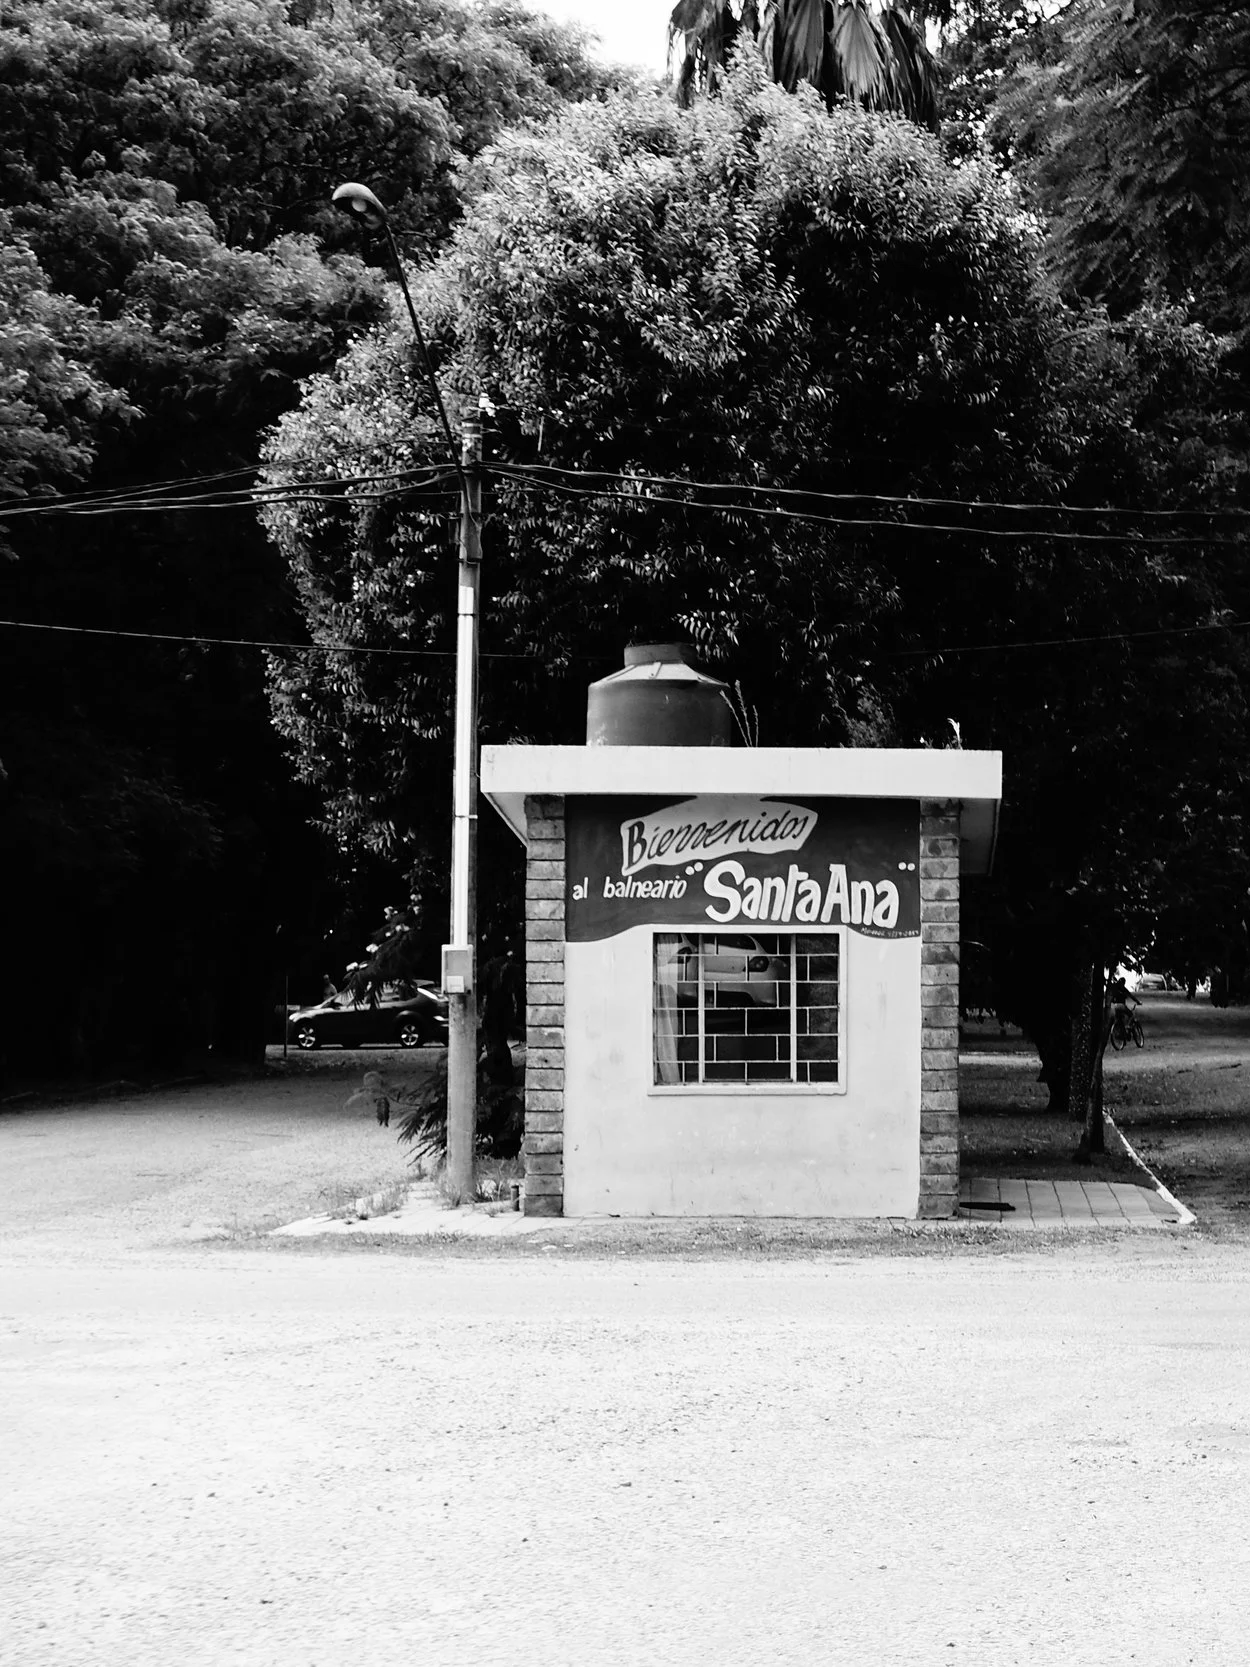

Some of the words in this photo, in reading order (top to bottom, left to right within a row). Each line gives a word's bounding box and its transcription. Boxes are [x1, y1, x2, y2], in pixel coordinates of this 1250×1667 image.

[627, 810, 808, 866] Bienvenidos
[572, 876, 589, 901] al
[603, 875, 688, 900] balneario
